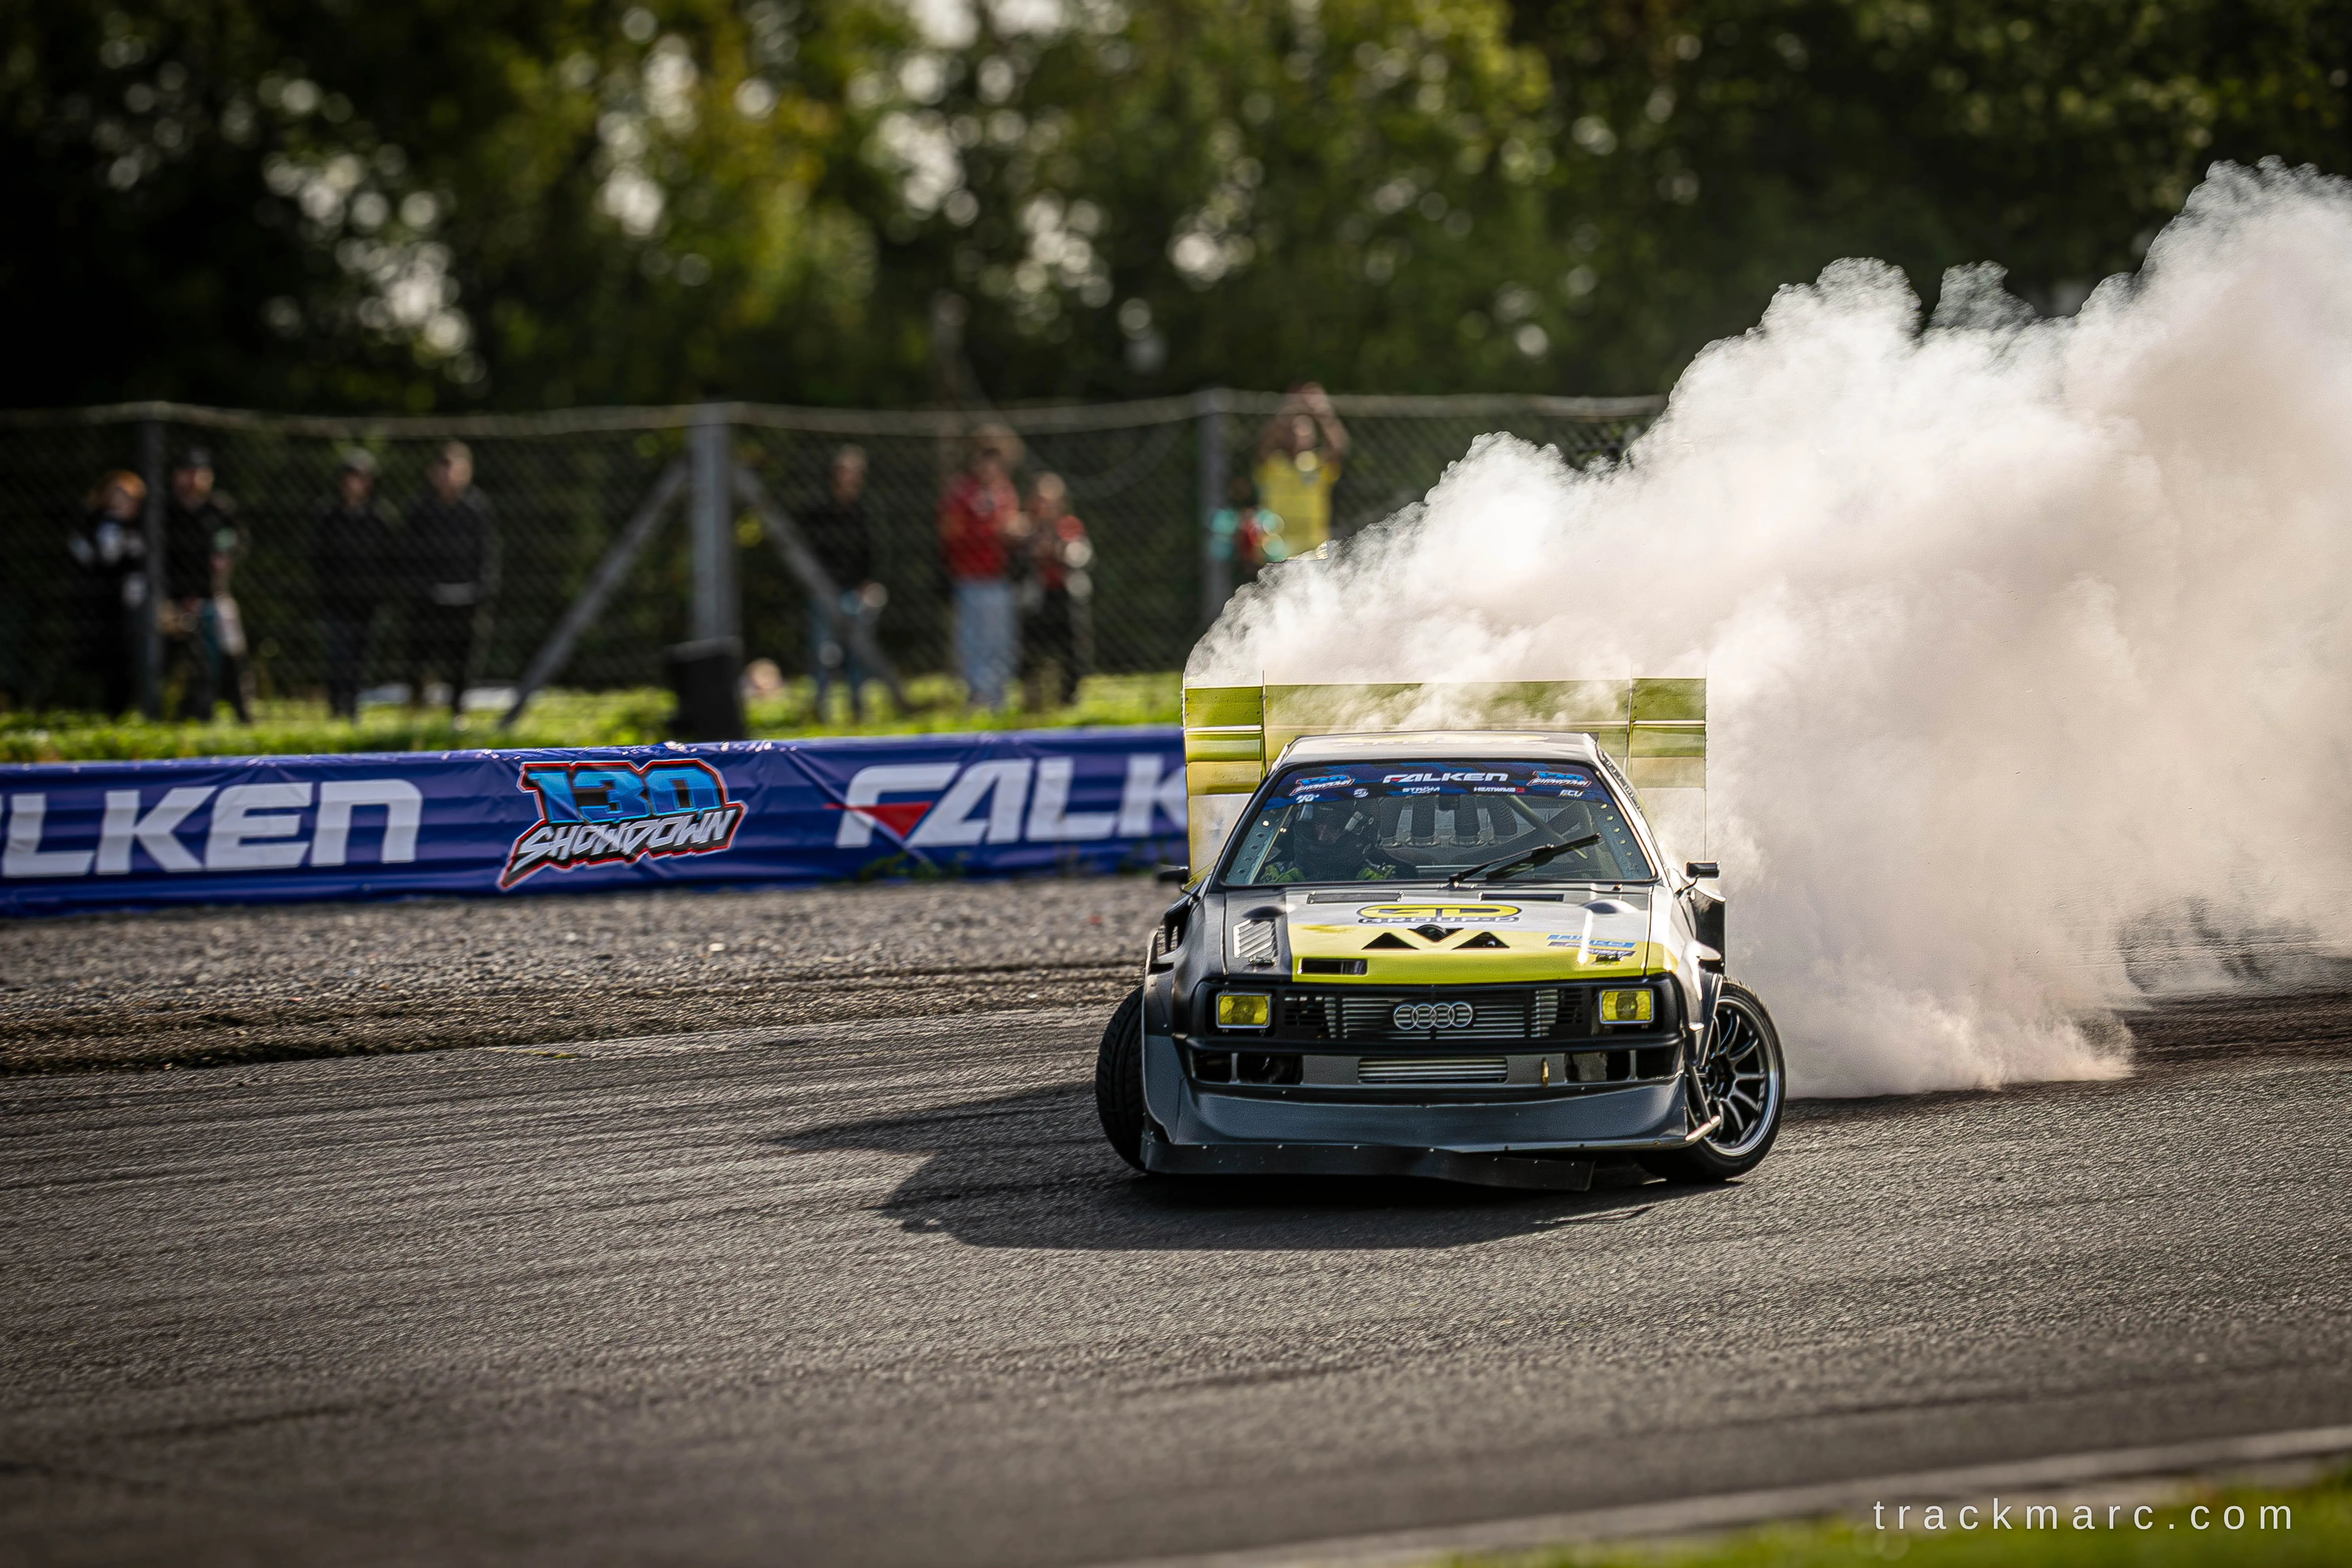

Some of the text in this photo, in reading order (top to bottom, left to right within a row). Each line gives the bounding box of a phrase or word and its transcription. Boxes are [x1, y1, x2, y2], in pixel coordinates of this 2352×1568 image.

[527, 767, 723, 823] 130
[1382, 773, 1508, 783] FALKEN
[0, 779, 422, 877] LKEN
[509, 809, 736, 873] SHOWDOWN
